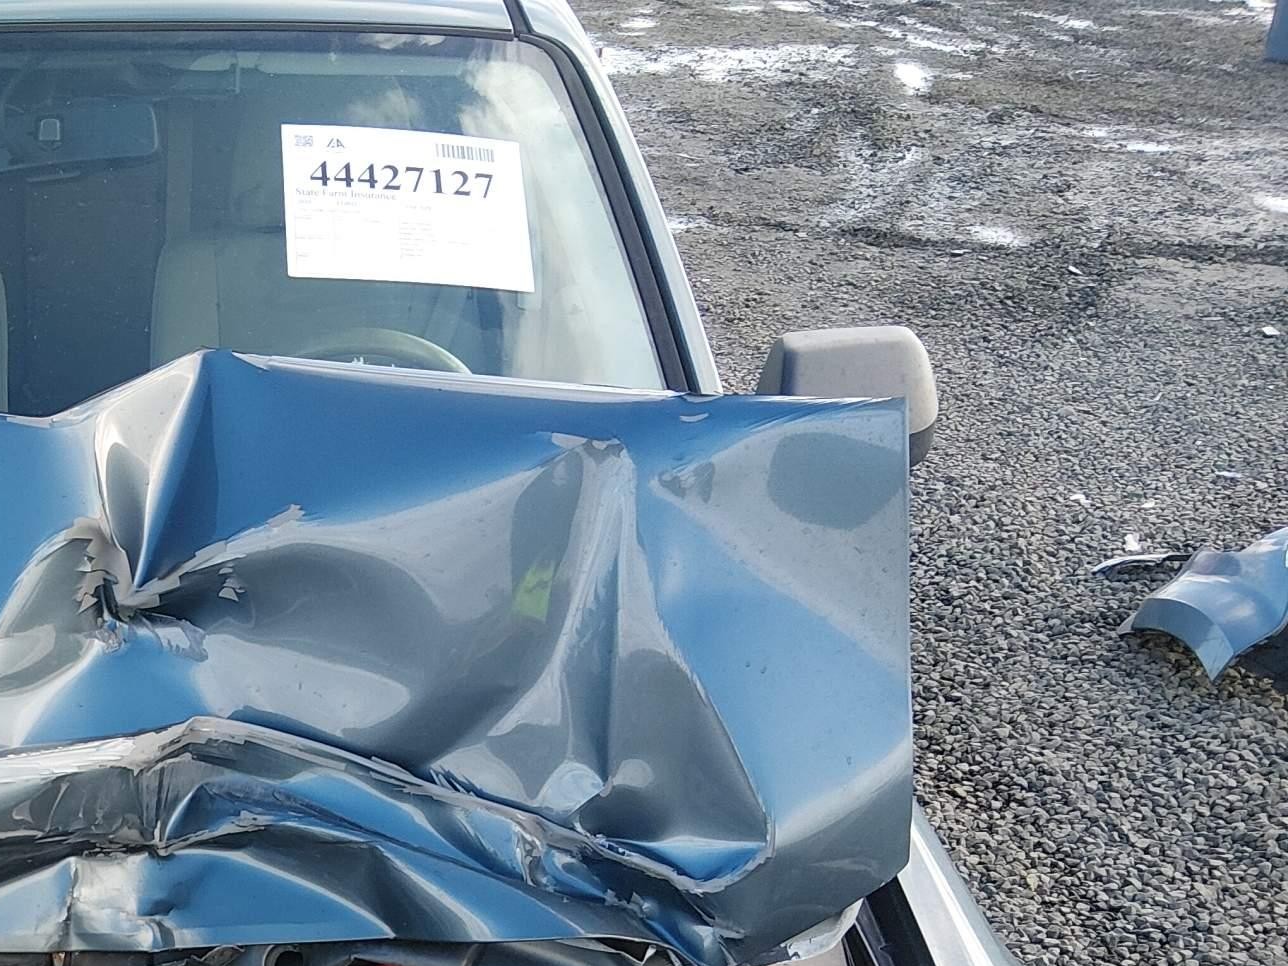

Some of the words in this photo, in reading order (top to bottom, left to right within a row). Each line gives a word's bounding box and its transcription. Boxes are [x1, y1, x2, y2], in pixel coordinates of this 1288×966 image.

[310, 160, 494, 198] 44427127
[295, 187, 319, 197] State
[351, 190, 397, 201] Insurance
